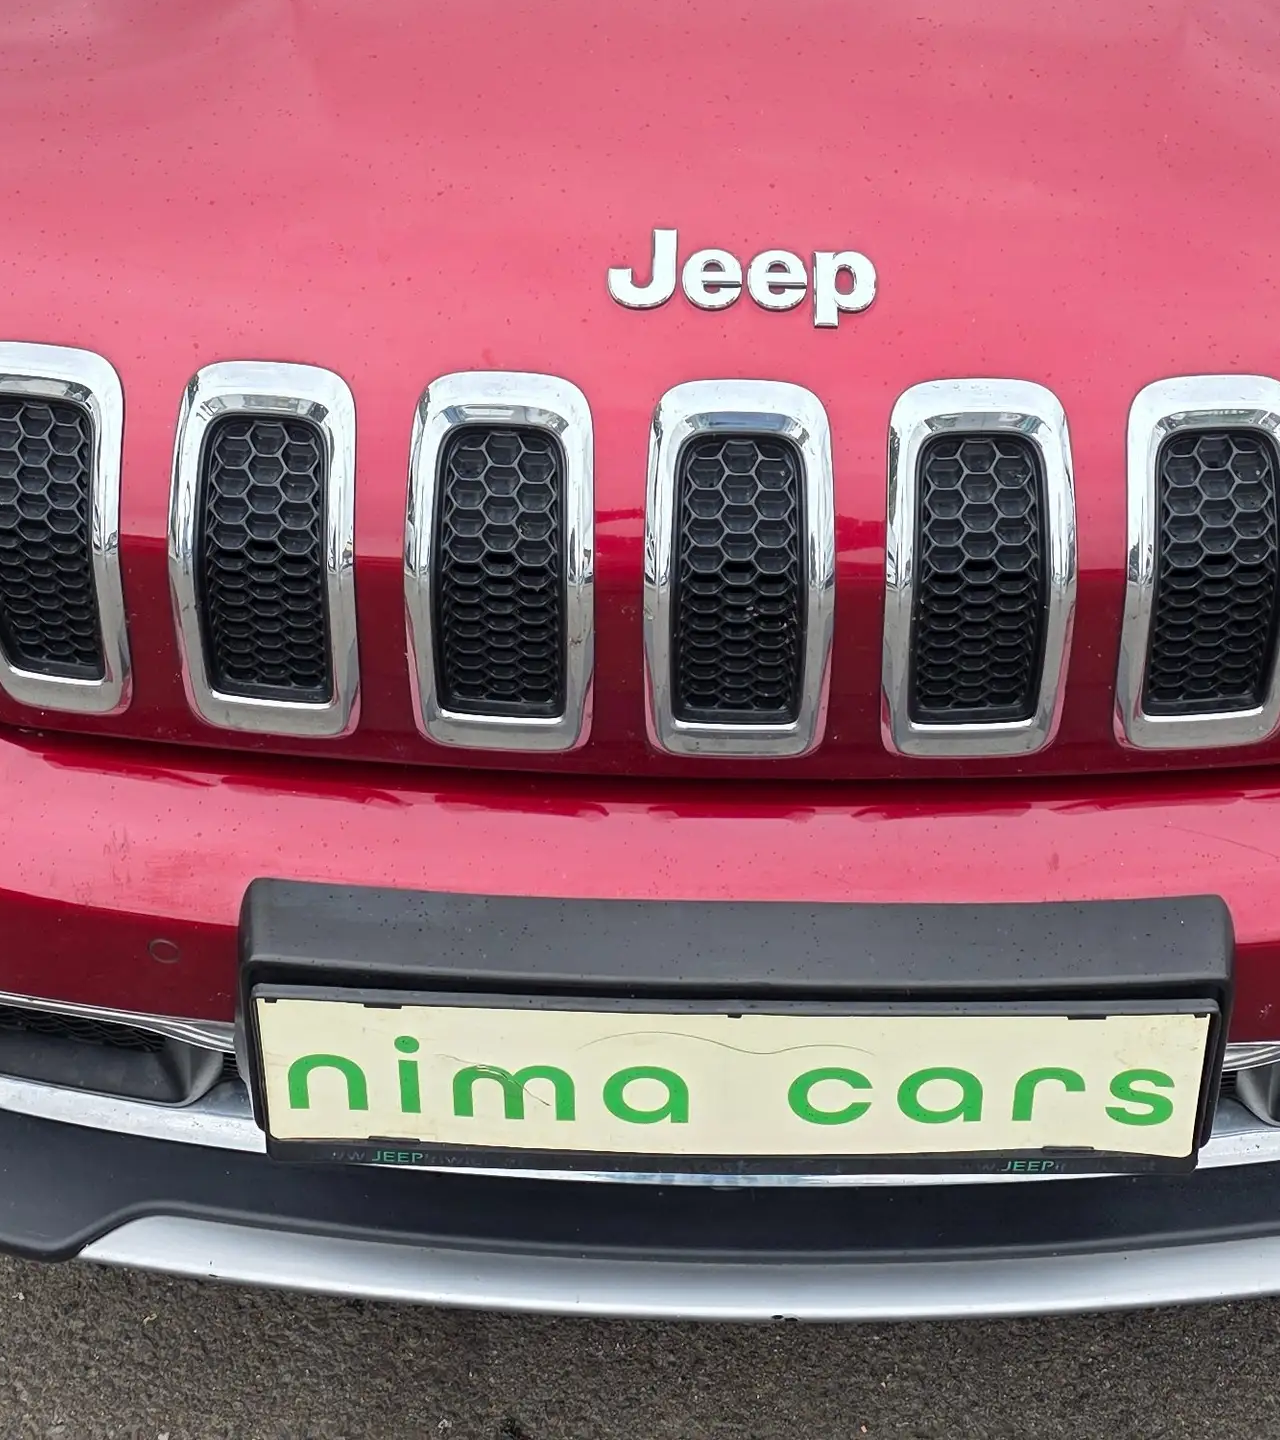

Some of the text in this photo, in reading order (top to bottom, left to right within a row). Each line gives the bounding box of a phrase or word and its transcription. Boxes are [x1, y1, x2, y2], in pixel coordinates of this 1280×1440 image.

[607, 227, 877, 329] Jeep
[287, 1035, 1176, 1126] nima cars
